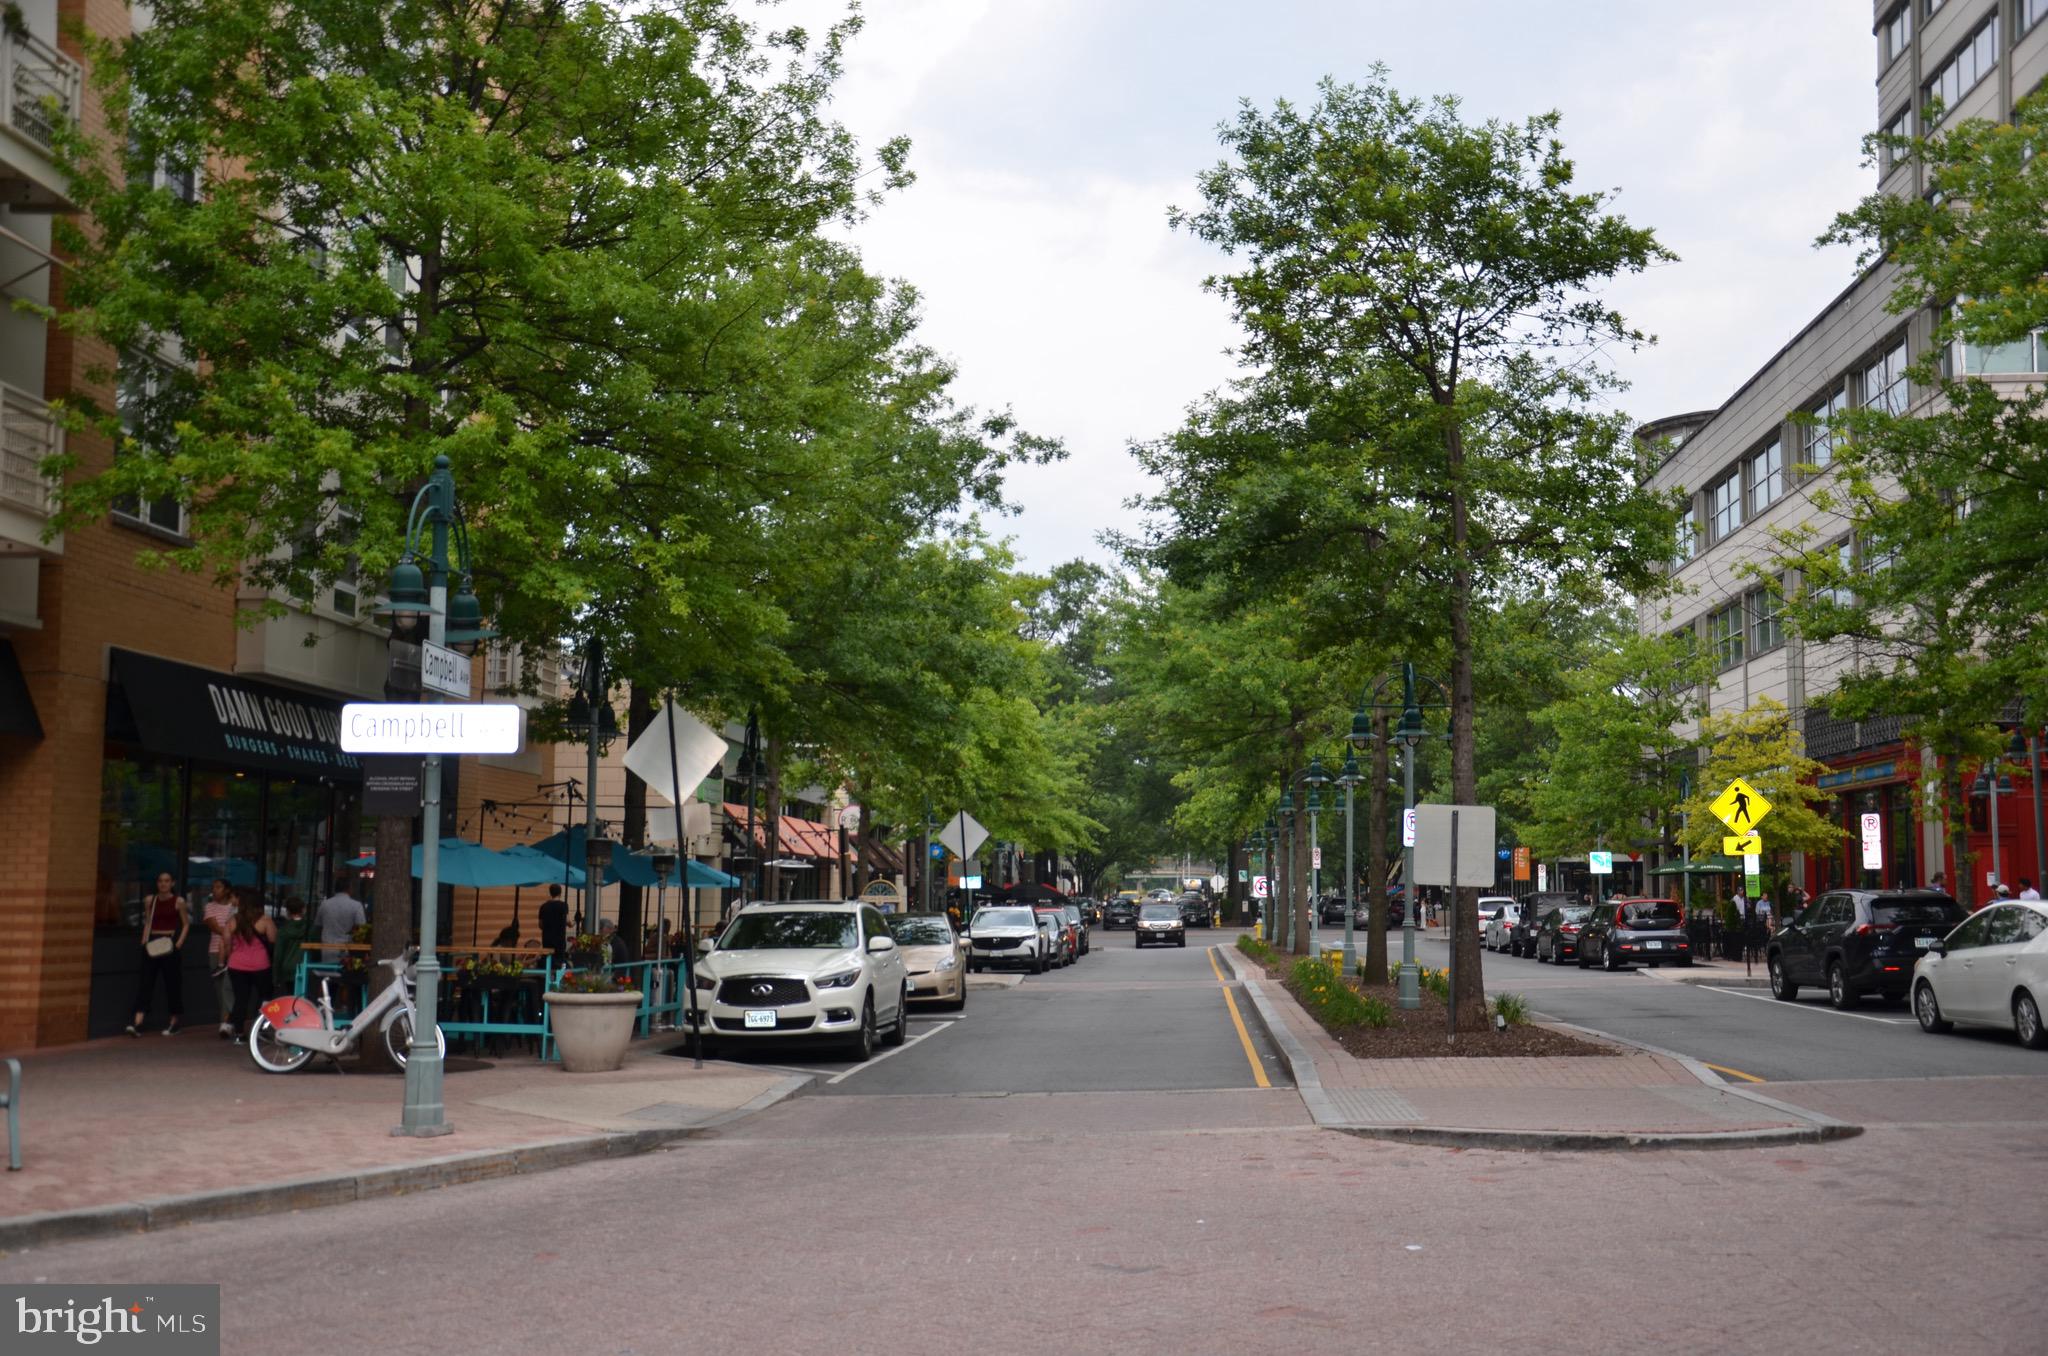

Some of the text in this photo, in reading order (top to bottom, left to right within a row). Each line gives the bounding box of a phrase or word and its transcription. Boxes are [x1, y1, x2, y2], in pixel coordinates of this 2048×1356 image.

[424, 648, 458, 686] Campbell
[208, 683, 267, 731] DAMN
[264, 696, 312, 740] GOOD
[351, 712, 464, 744] Campbell
[224, 734, 278, 756] BURGERS
[287, 745, 328, 764] SHAKES
